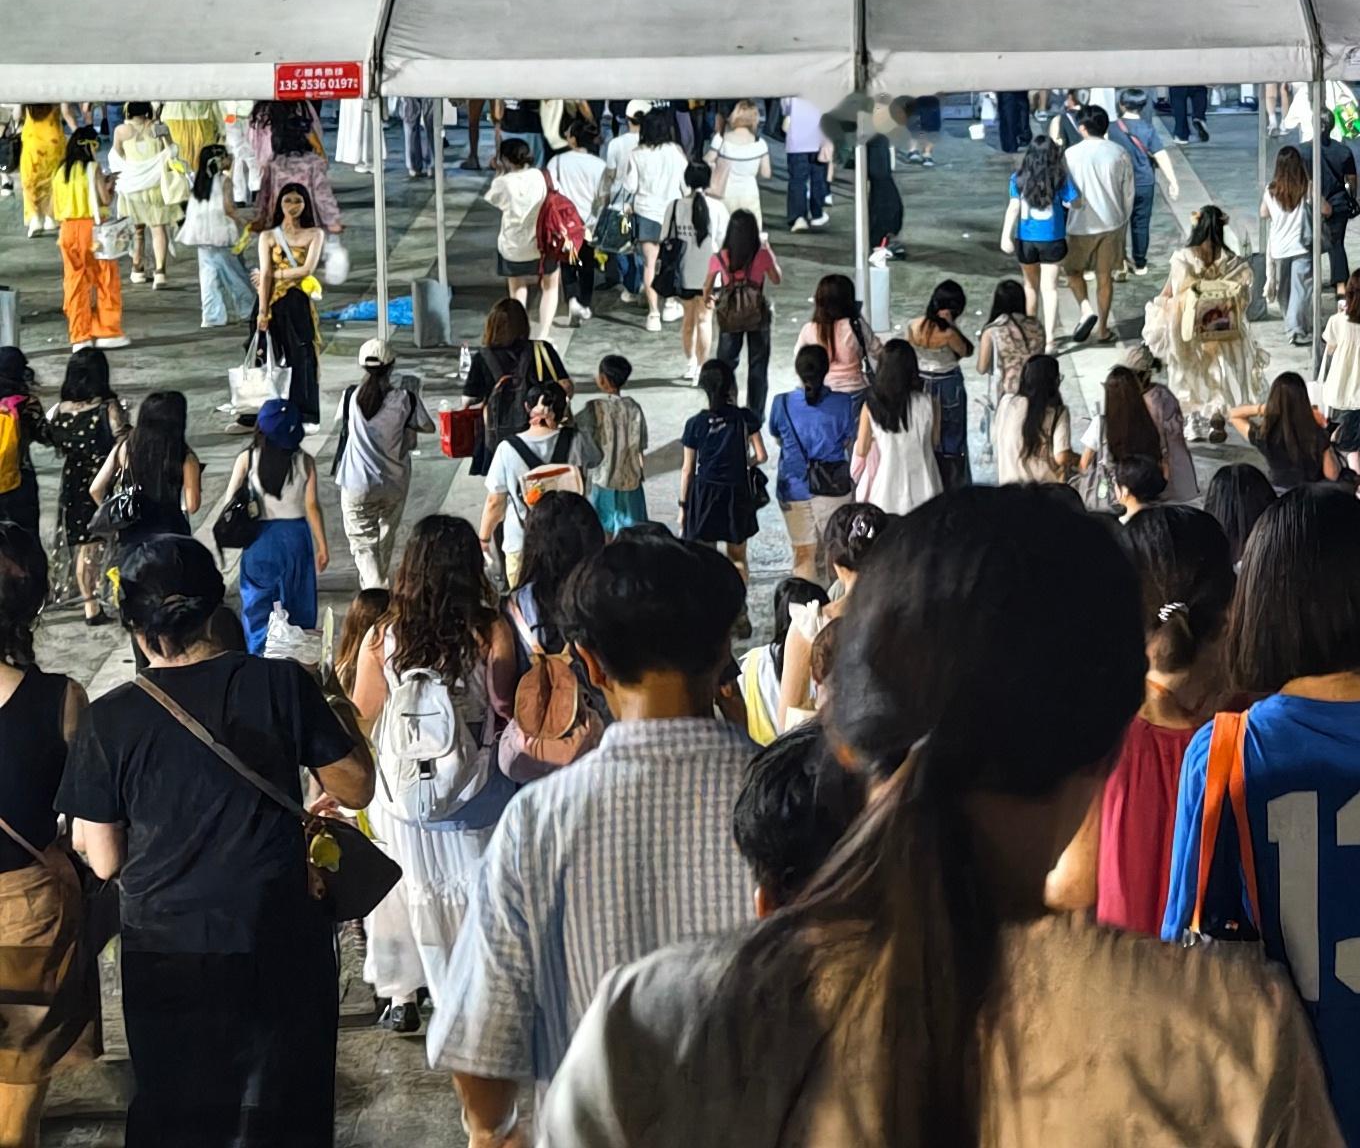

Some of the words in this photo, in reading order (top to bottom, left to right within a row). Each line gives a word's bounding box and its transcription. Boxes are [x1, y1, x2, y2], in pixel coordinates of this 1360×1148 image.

[279, 79, 299, 91] 135
[300, 79, 326, 90] 3536
[327, 78, 354, 89] 0197
